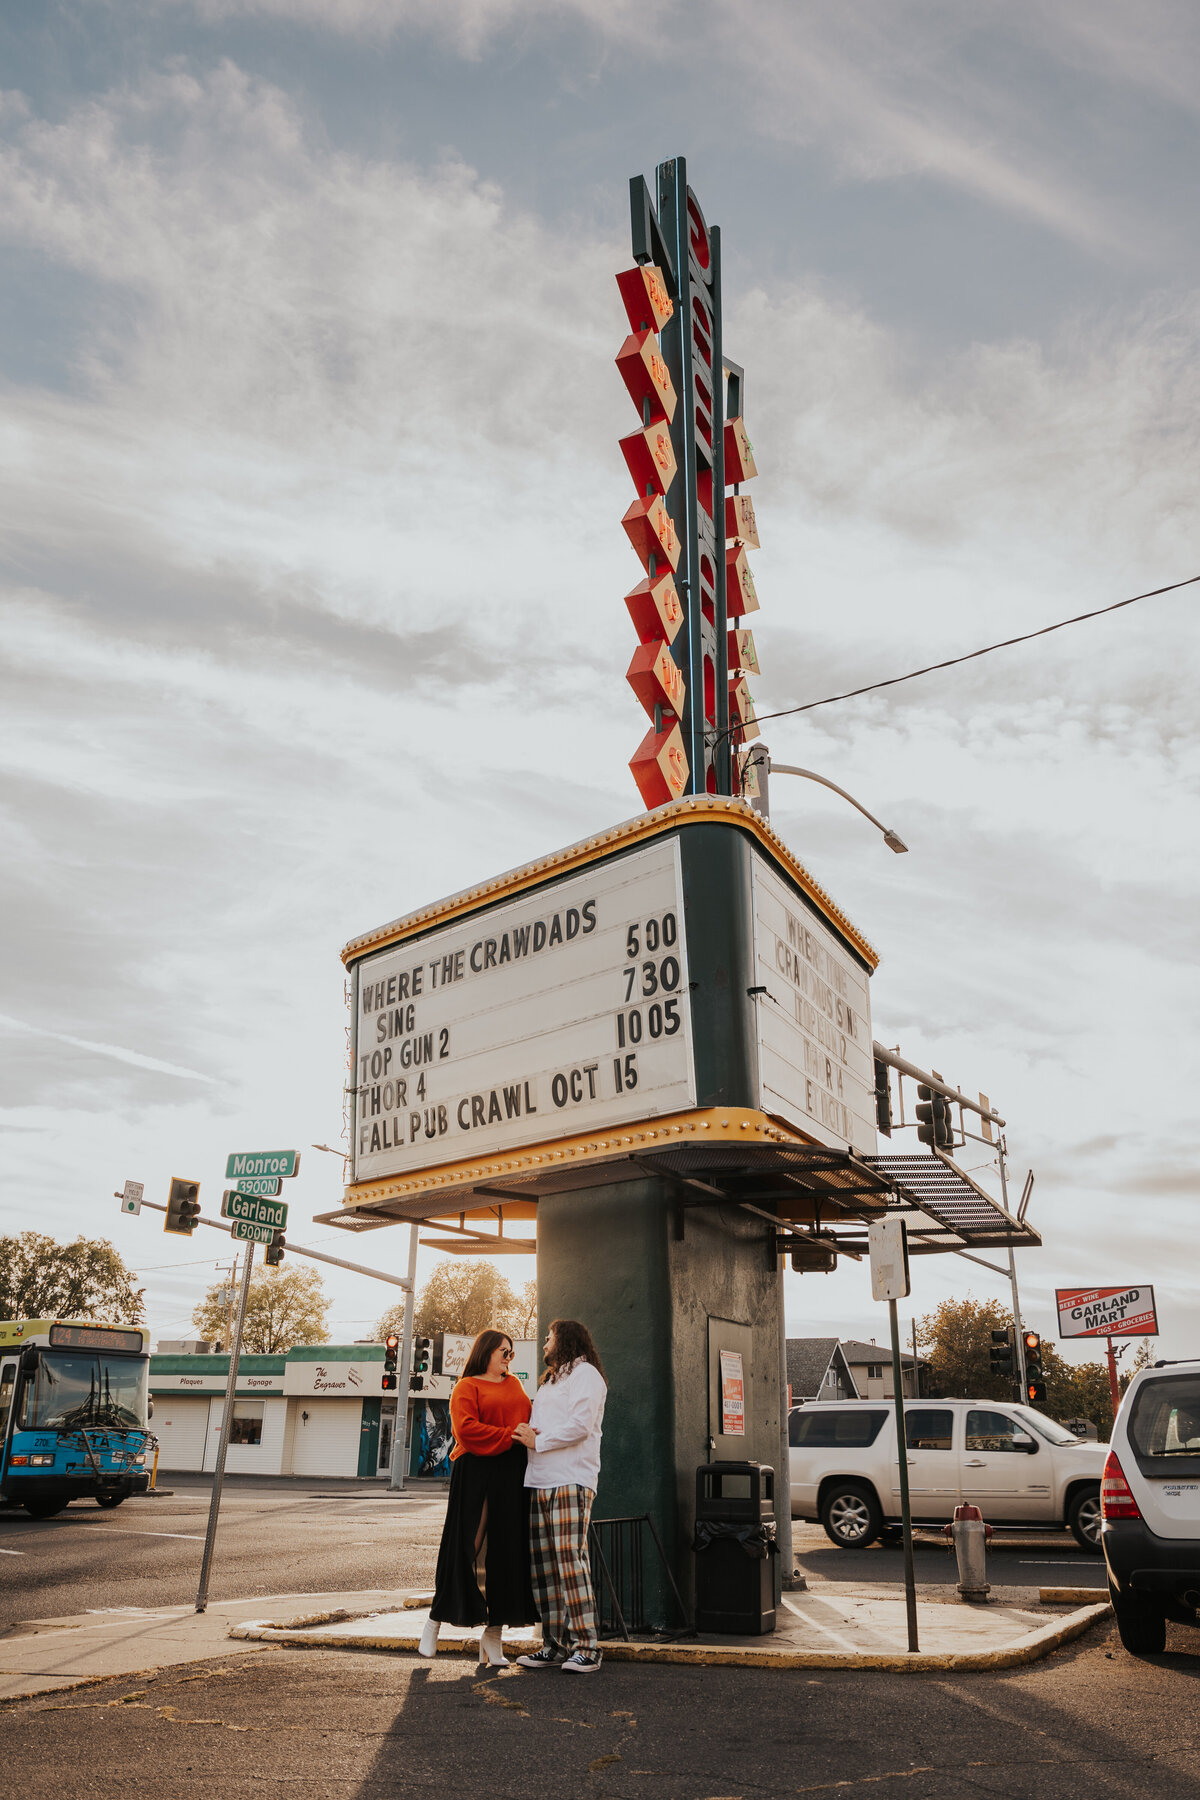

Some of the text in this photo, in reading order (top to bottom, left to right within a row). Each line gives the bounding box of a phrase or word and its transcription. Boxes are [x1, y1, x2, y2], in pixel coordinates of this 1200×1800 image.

[363, 900, 597, 1014] WHERE THE CRAWDADS
[376, 1003, 415, 1043] SING
[360, 1046, 392, 1082] TOP
[400, 1032, 433, 1069] GUN
[439, 1028, 449, 1058] 2
[360, 1079, 406, 1119] THOR
[416, 1072, 426, 1102] 4
[360, 1053, 638, 1155] FALL PUB CRAWL OCT 15
[233, 1155, 288, 1175] Monroe
[240, 1181, 276, 1194] 3900N
[232, 1195, 284, 1225] Garland
[240, 1224, 270, 1242] 900W
[1059, 1292, 1099, 1310] BEER WINE
[1071, 1290, 1140, 1320] GARLAND
[1085, 1306, 1127, 1329] MART
[1096, 1312, 1154, 1335] CIGS GROCERIES
[456, 1340, 466, 1352] The
[179, 1377, 203, 1386] Plaques
[247, 1378, 273, 1387] Signage
[315, 1367, 328, 1378] The
[313, 1378, 346, 1392] Engraver
